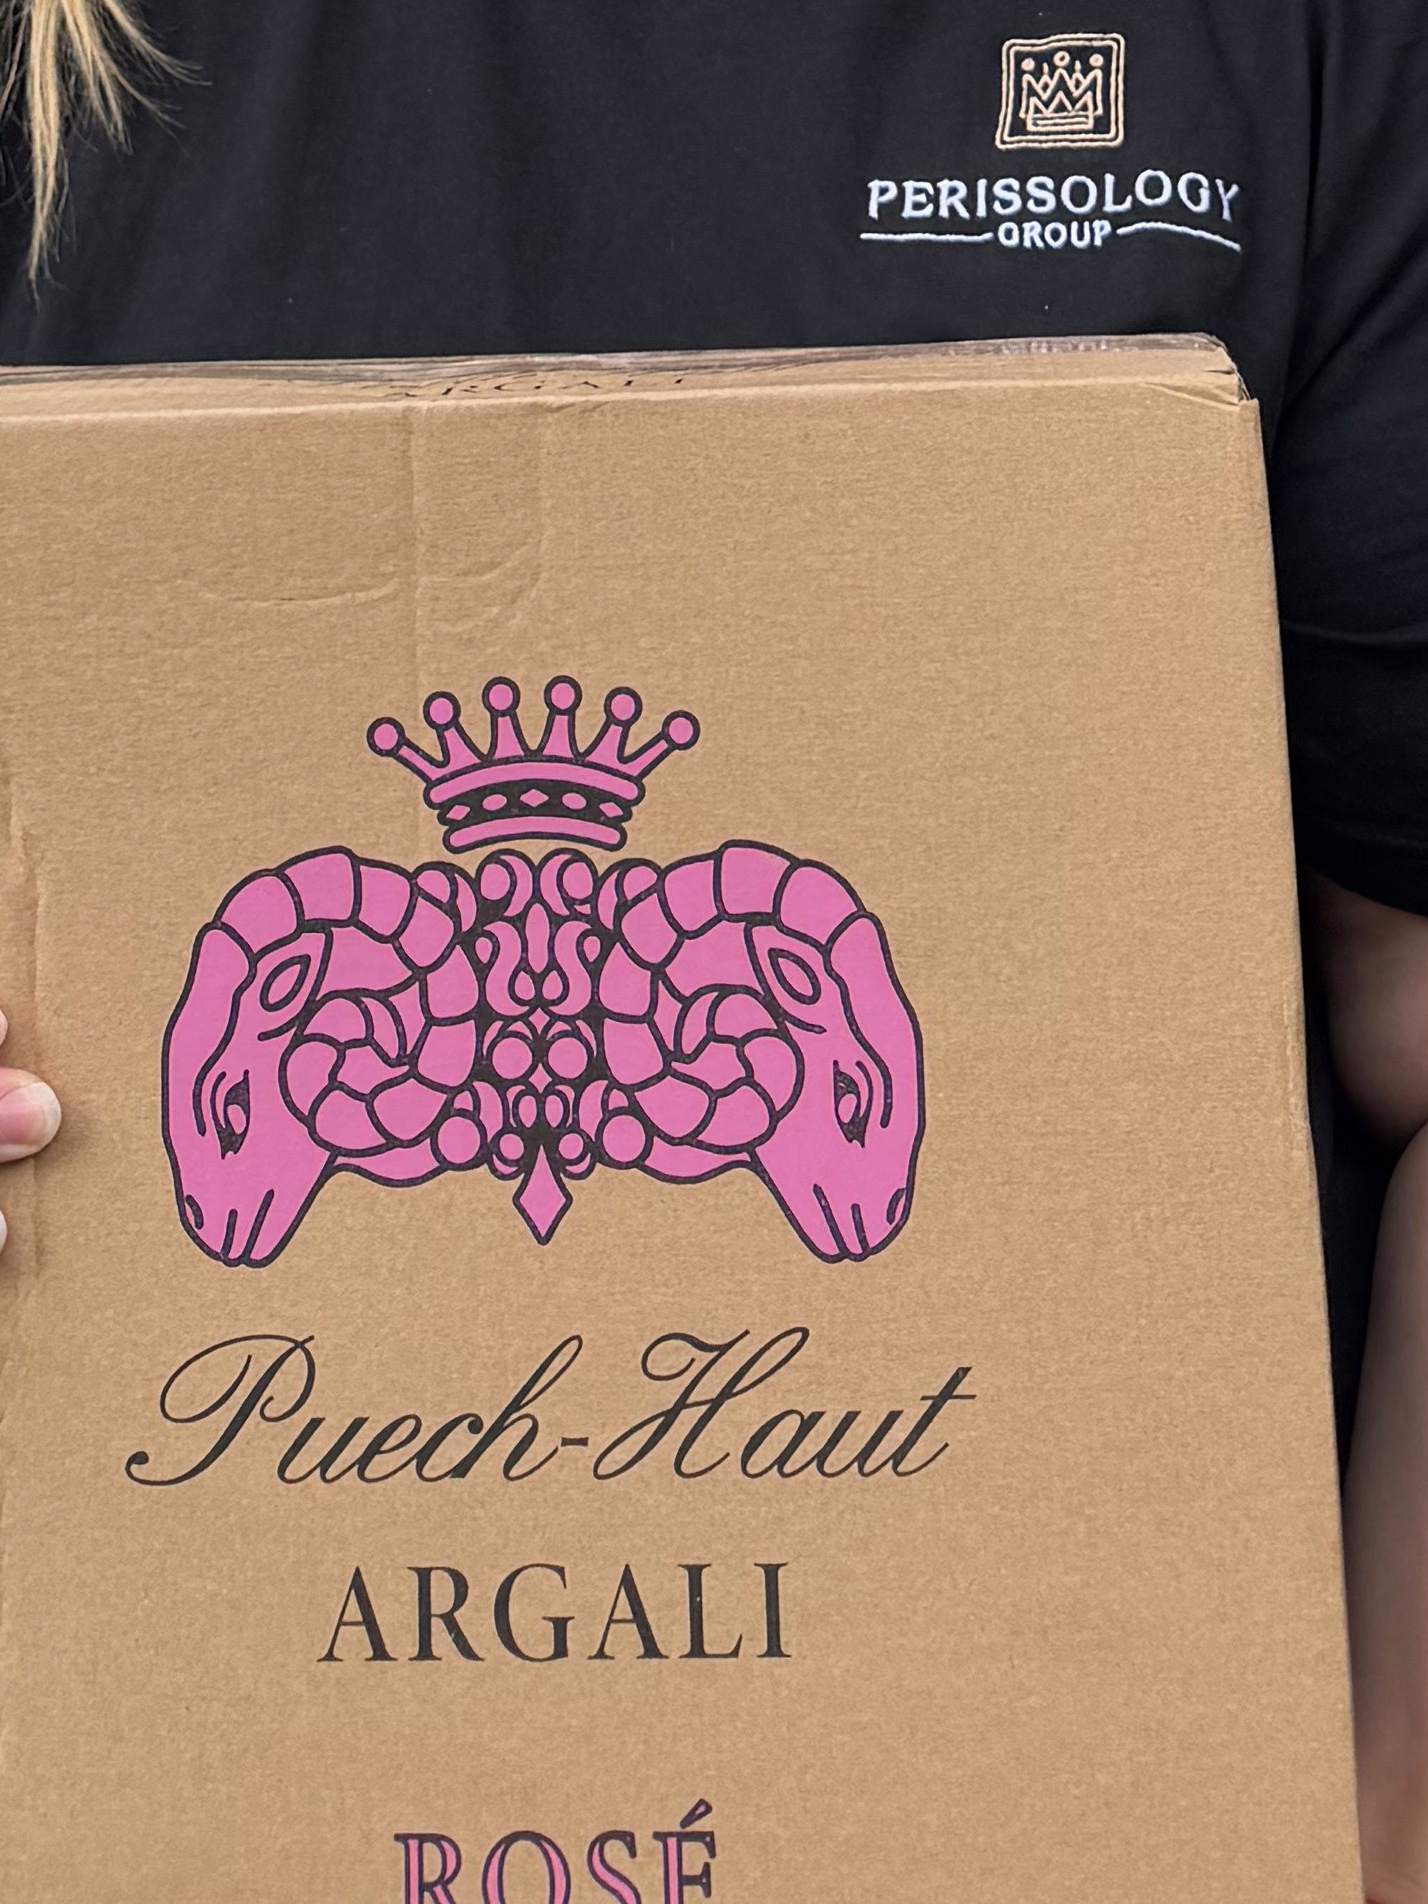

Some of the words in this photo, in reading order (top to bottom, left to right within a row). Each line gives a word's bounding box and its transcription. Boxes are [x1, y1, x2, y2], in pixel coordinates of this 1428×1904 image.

[867, 168, 1240, 222] PERISSOLOGY
[997, 220, 1113, 249] GROUP
[124, 1326, 977, 1487] Puech-Haut
[316, 1562, 792, 1663] ARGALI
[393, 1798, 717, 1904] ROSÉ
